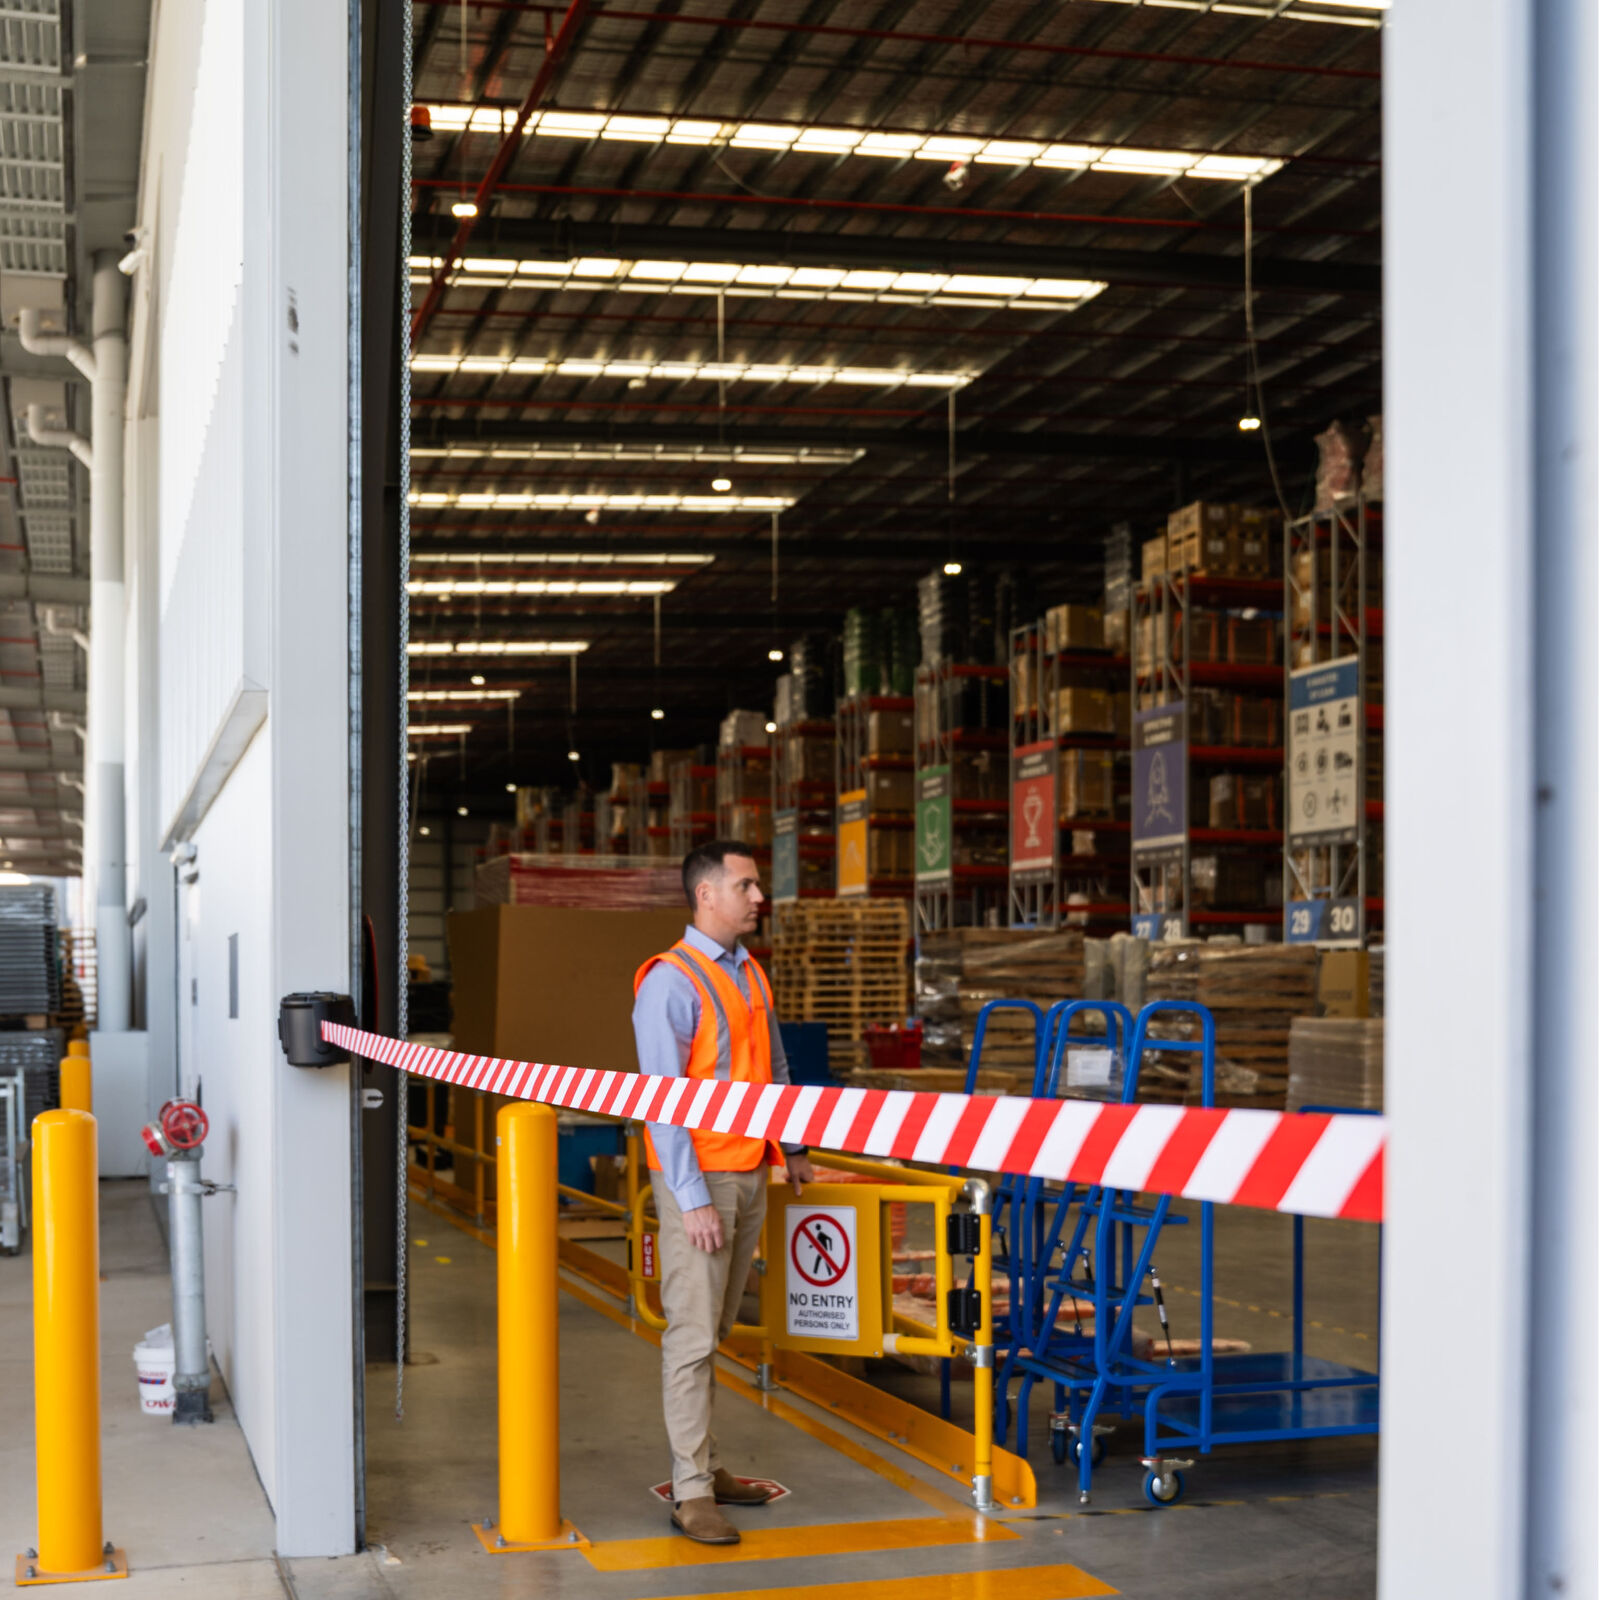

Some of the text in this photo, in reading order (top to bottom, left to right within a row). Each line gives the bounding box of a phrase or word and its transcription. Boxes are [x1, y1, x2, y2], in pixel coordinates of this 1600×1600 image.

[1291, 906, 1355, 935] 29 30
[643, 1235, 653, 1275] PUSH
[790, 1293, 854, 1308] NO ENTRY
[798, 1310, 846, 1320] AUTHORISED
[794, 1319, 850, 1330] PERSONS ONLY
